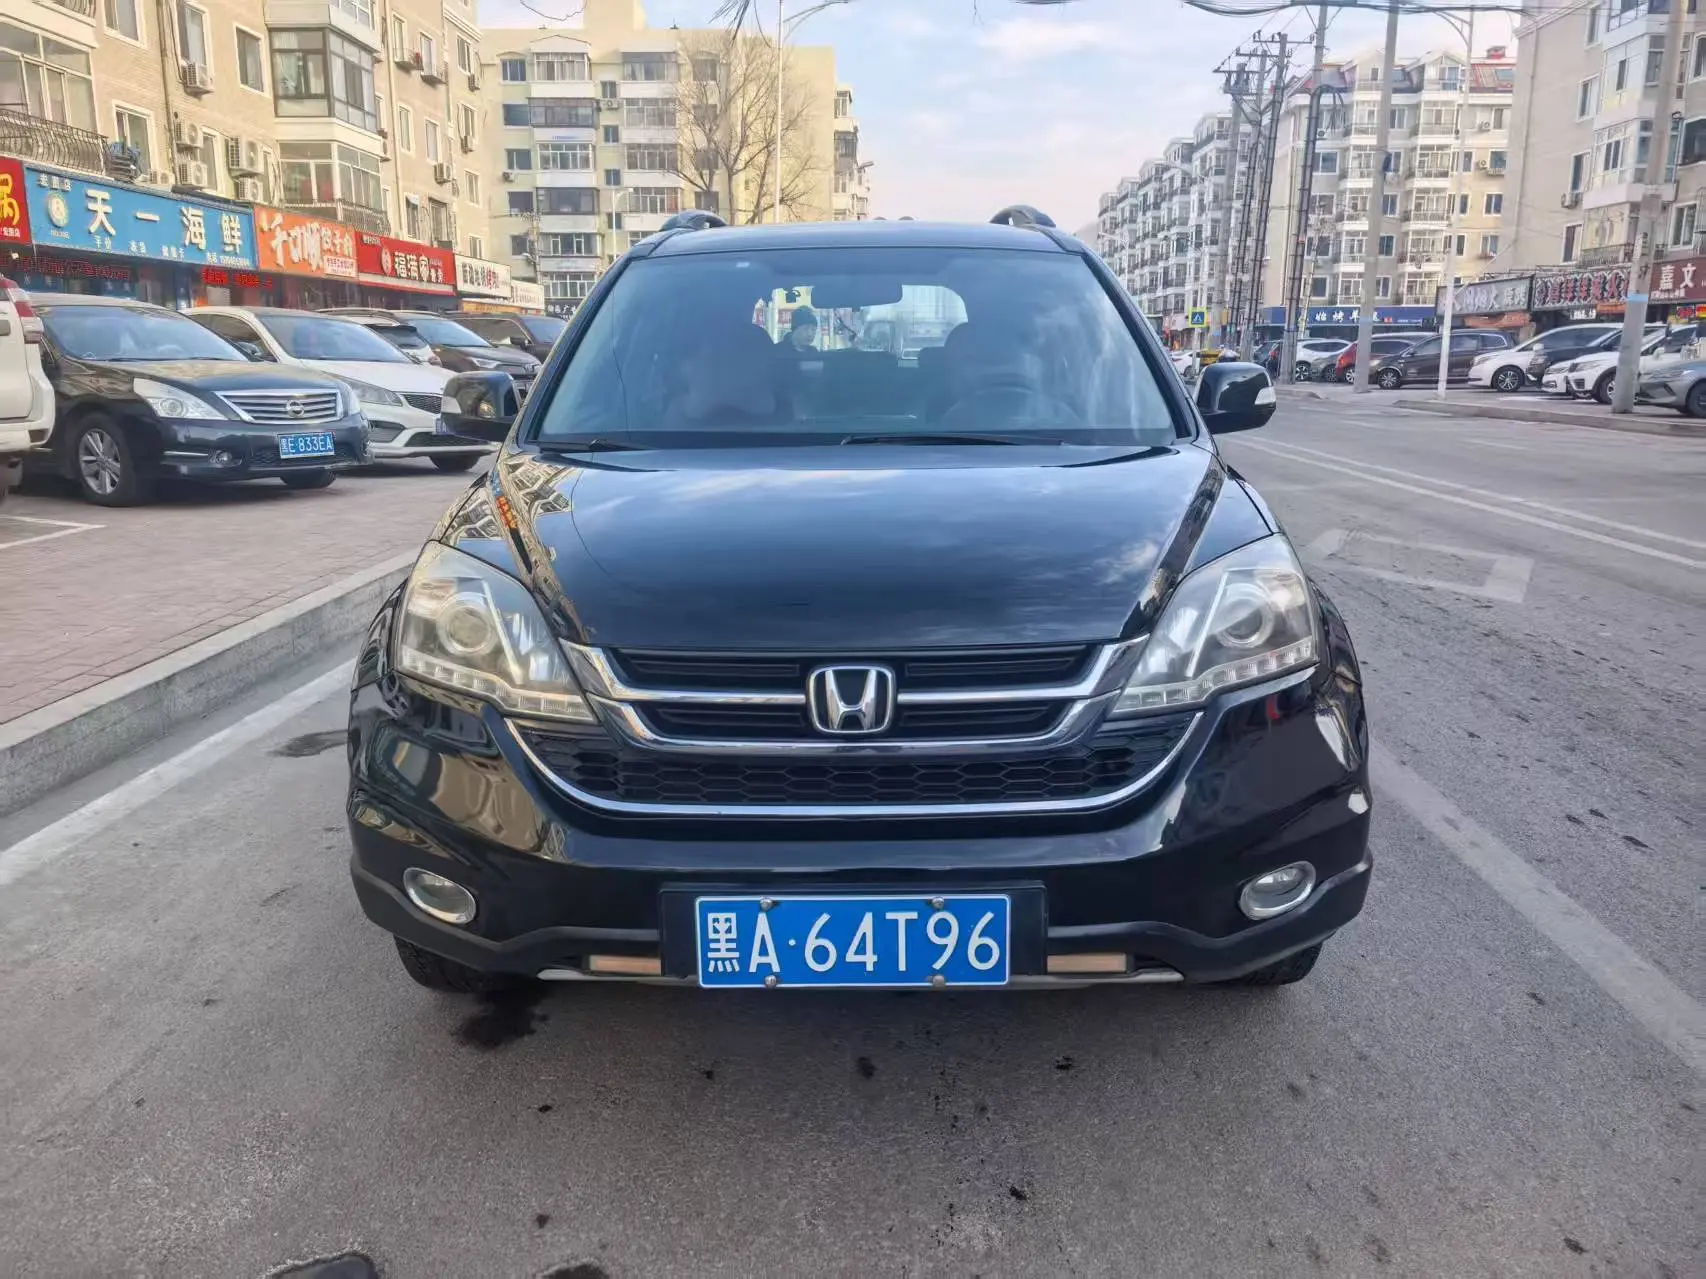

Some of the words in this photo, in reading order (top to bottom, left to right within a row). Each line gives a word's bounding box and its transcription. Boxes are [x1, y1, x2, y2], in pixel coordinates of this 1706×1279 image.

[85, 189, 242, 254] 天一海鲜
[707, 910, 1000, 973] 黑A·64T96
